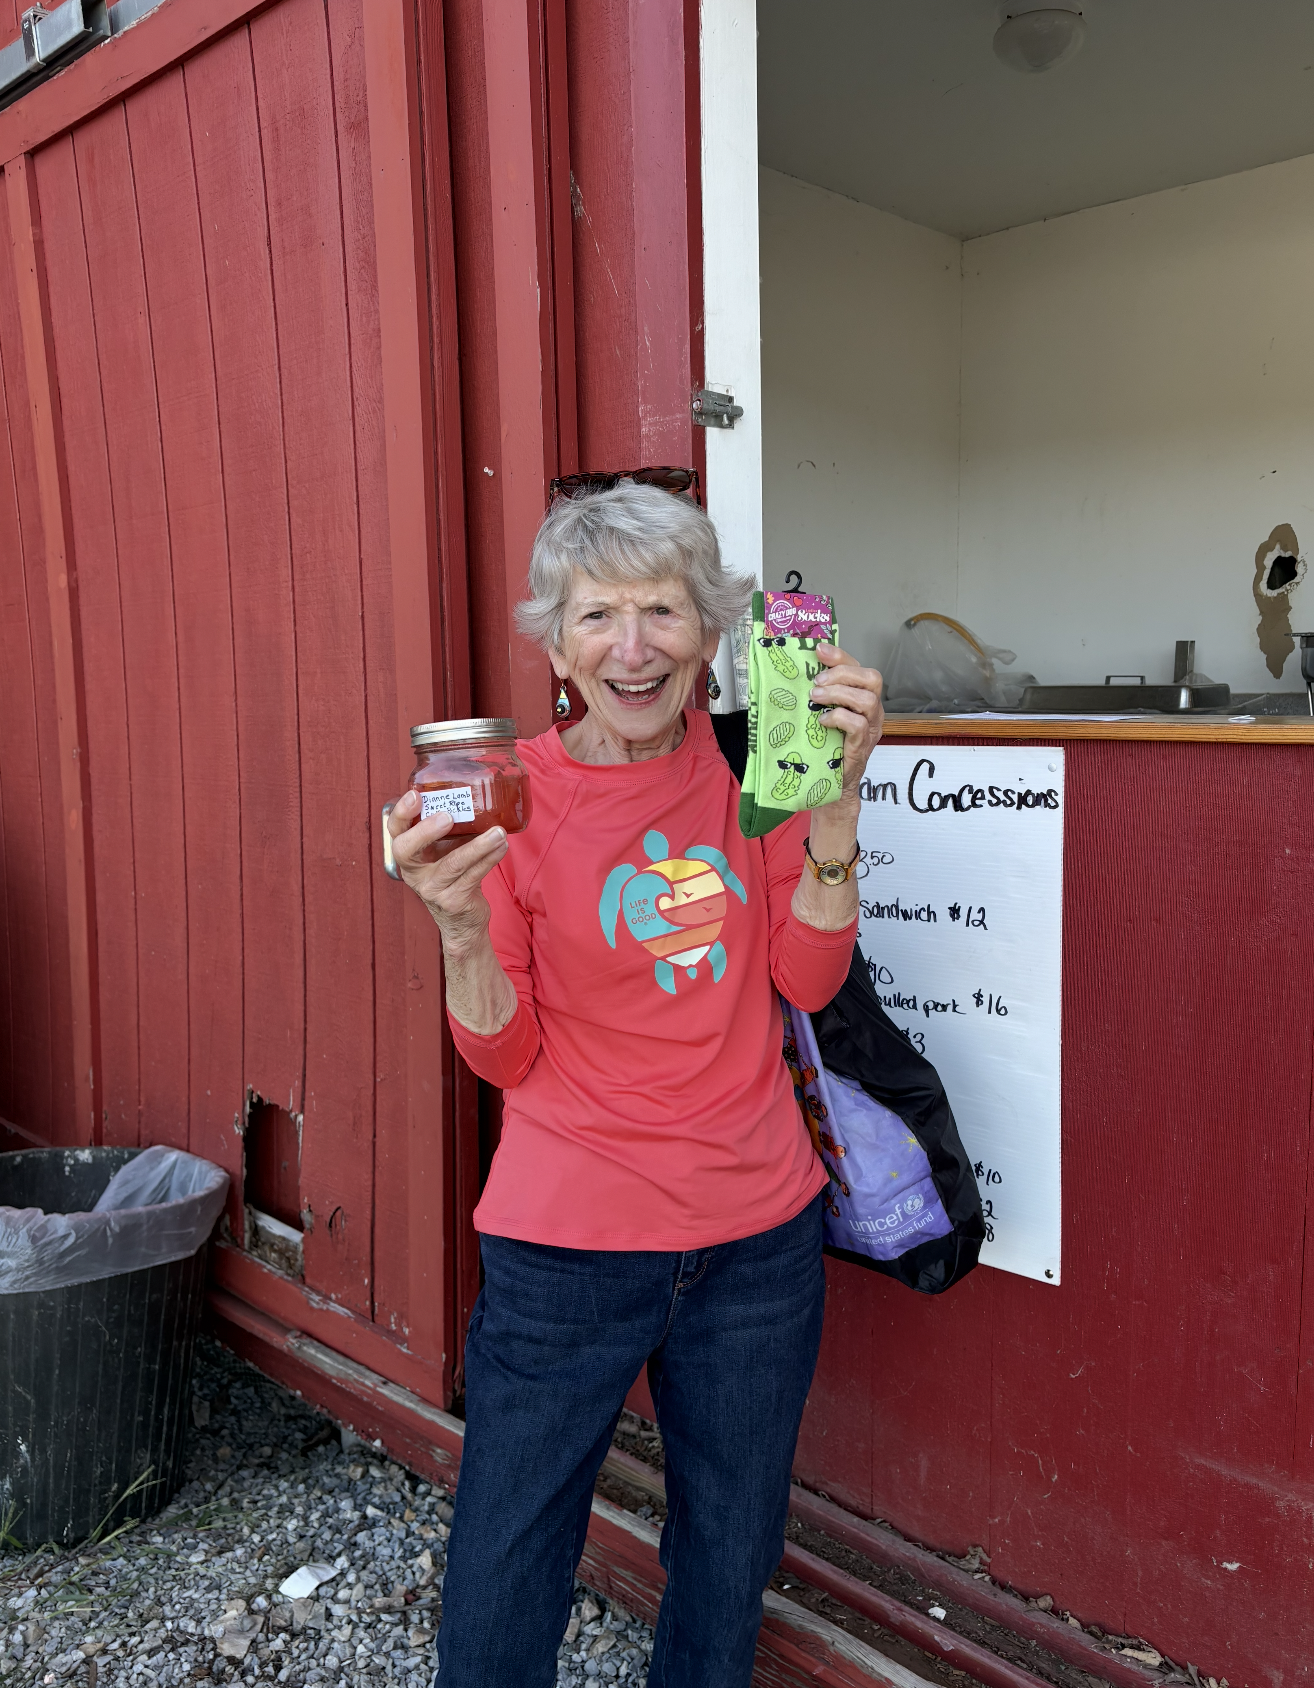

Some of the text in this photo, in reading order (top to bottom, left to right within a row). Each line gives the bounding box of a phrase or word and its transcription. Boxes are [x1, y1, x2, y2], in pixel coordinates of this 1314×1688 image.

[768, 610, 786, 621] CRAZY
[796, 609, 830, 622] Socks
[452, 791, 471, 800] Lamb
[908, 759, 1060, 813] Concessions
[631, 913, 657, 925] GOOD
[636, 908, 646, 916] IS
[923, 999, 967, 1018] pork
[972, 988, 1008, 1016] $16
[974, 1160, 1003, 1186] $10
[849, 1204, 903, 1233] unicef
[980, 1197, 999, 1220] 2
[857, 1211, 935, 1245] united states fund
